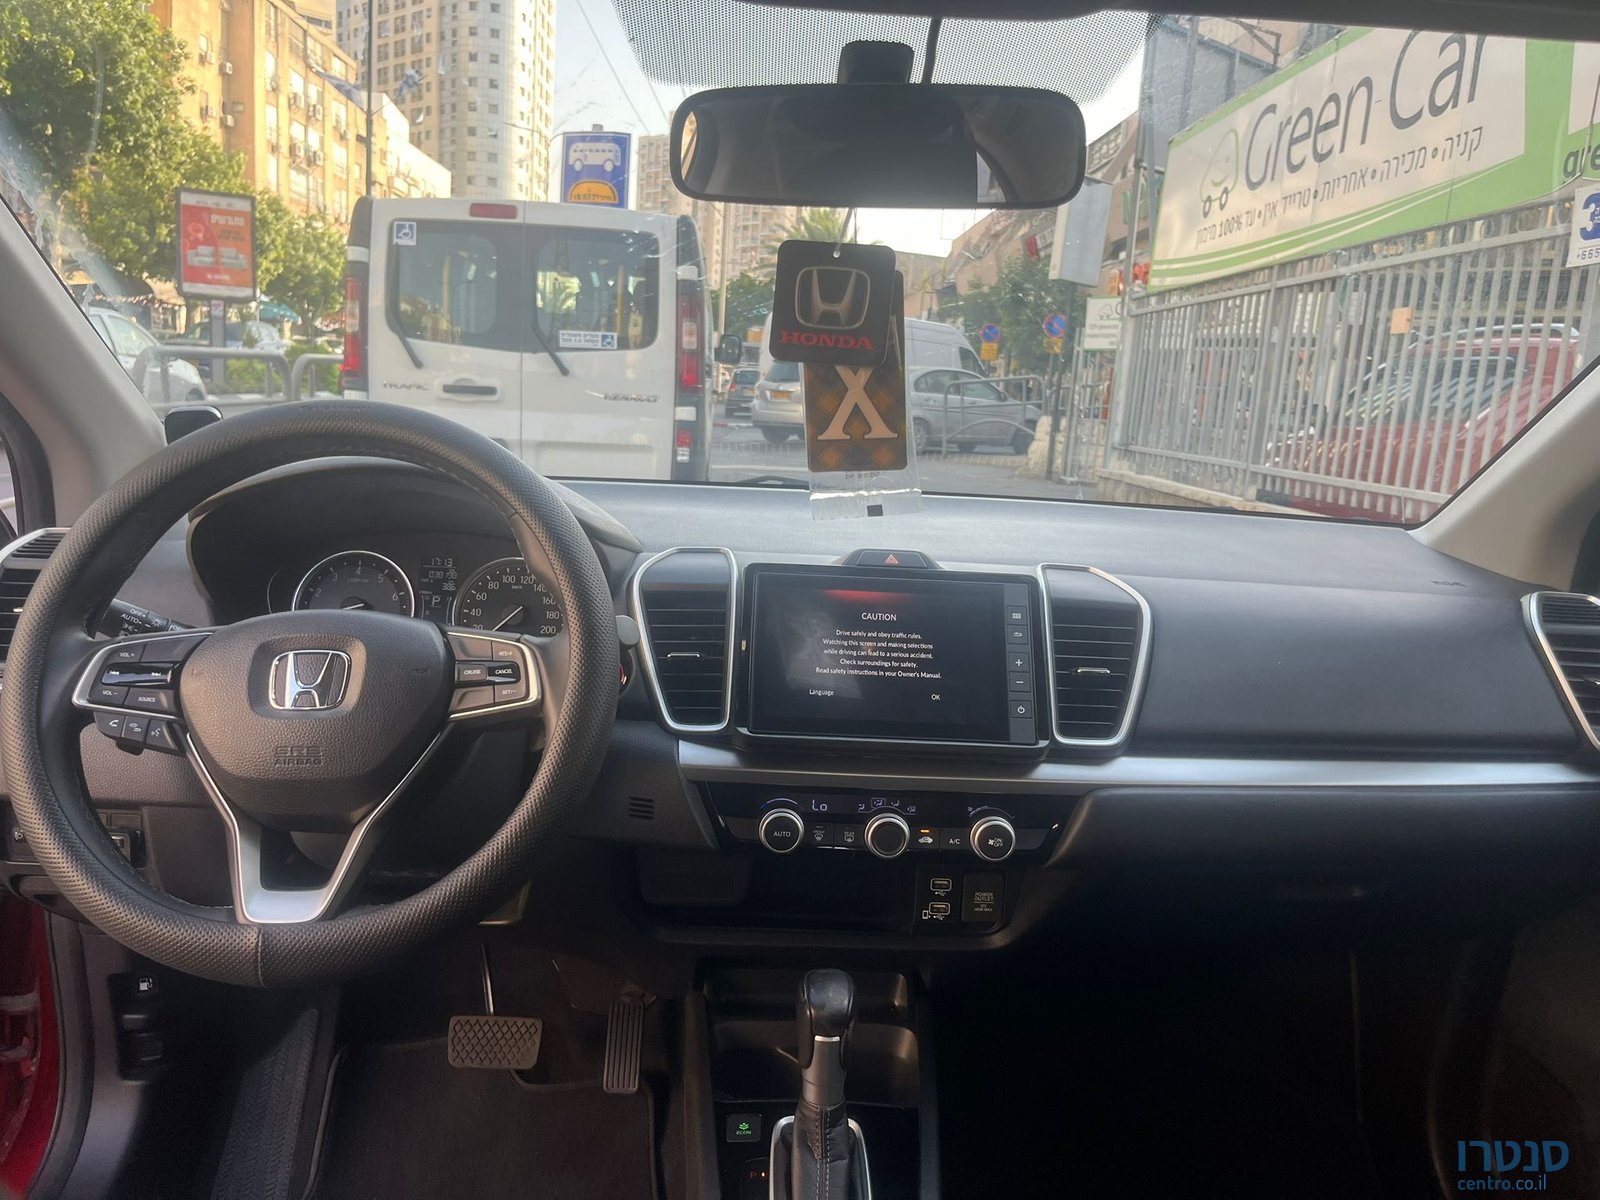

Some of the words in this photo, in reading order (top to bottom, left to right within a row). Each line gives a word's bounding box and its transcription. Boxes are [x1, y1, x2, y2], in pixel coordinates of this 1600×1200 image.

[1245, 76, 1374, 191] Green
[1389, 29, 1488, 130] Car
[1441, 126, 1483, 161] קניה
[1380, 146, 1427, 182] מכירה
[1320, 167, 1368, 202] אחריות
[1281, 187, 1311, 216] טרייד
[1218, 213, 1243, 238] 100%
[780, 330, 874, 350] HONDA
[502, 575, 516, 583] 100
[520, 576, 534, 584] 120
[488, 582, 500, 590] 80
[476, 592, 487, 600] 60
[470, 608, 482, 616] 40
[546, 611, 560, 619] 180
[121, 614, 140, 624] AUTO
[861, 612, 897, 621] CAUTION
[540, 626, 556, 634] 200
[851, 630, 866, 638] safely
[822, 638, 848, 646] Watching
[830, 667, 846, 675] safety
[847, 668, 878, 676] instructions
[809, 689, 835, 697] Language
[812, 800, 828, 811] Lo
[949, 838, 961, 846] A/C
